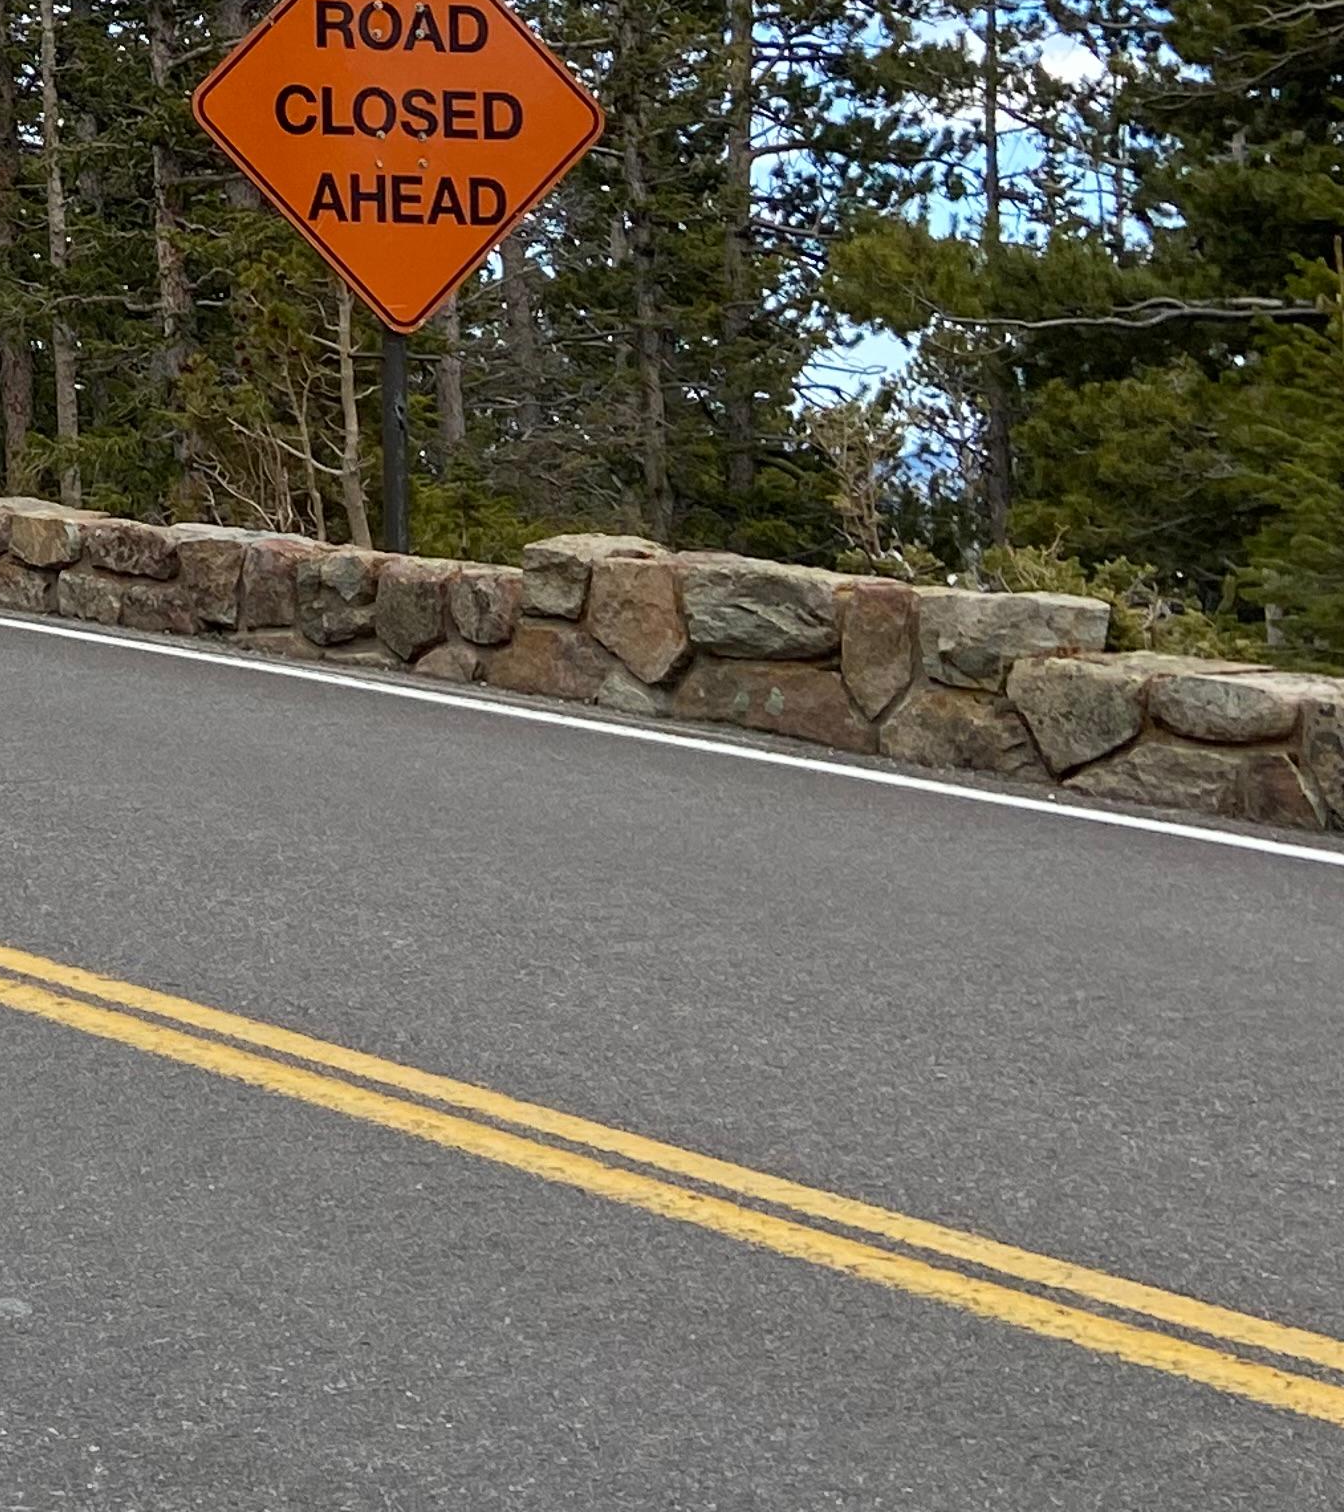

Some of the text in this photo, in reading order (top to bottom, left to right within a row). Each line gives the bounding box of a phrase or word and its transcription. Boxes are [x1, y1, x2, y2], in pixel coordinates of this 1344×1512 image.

[314, 0, 489, 53] ROAD
[274, 84, 524, 141] CLOSED
[308, 172, 508, 226] AHEAD
